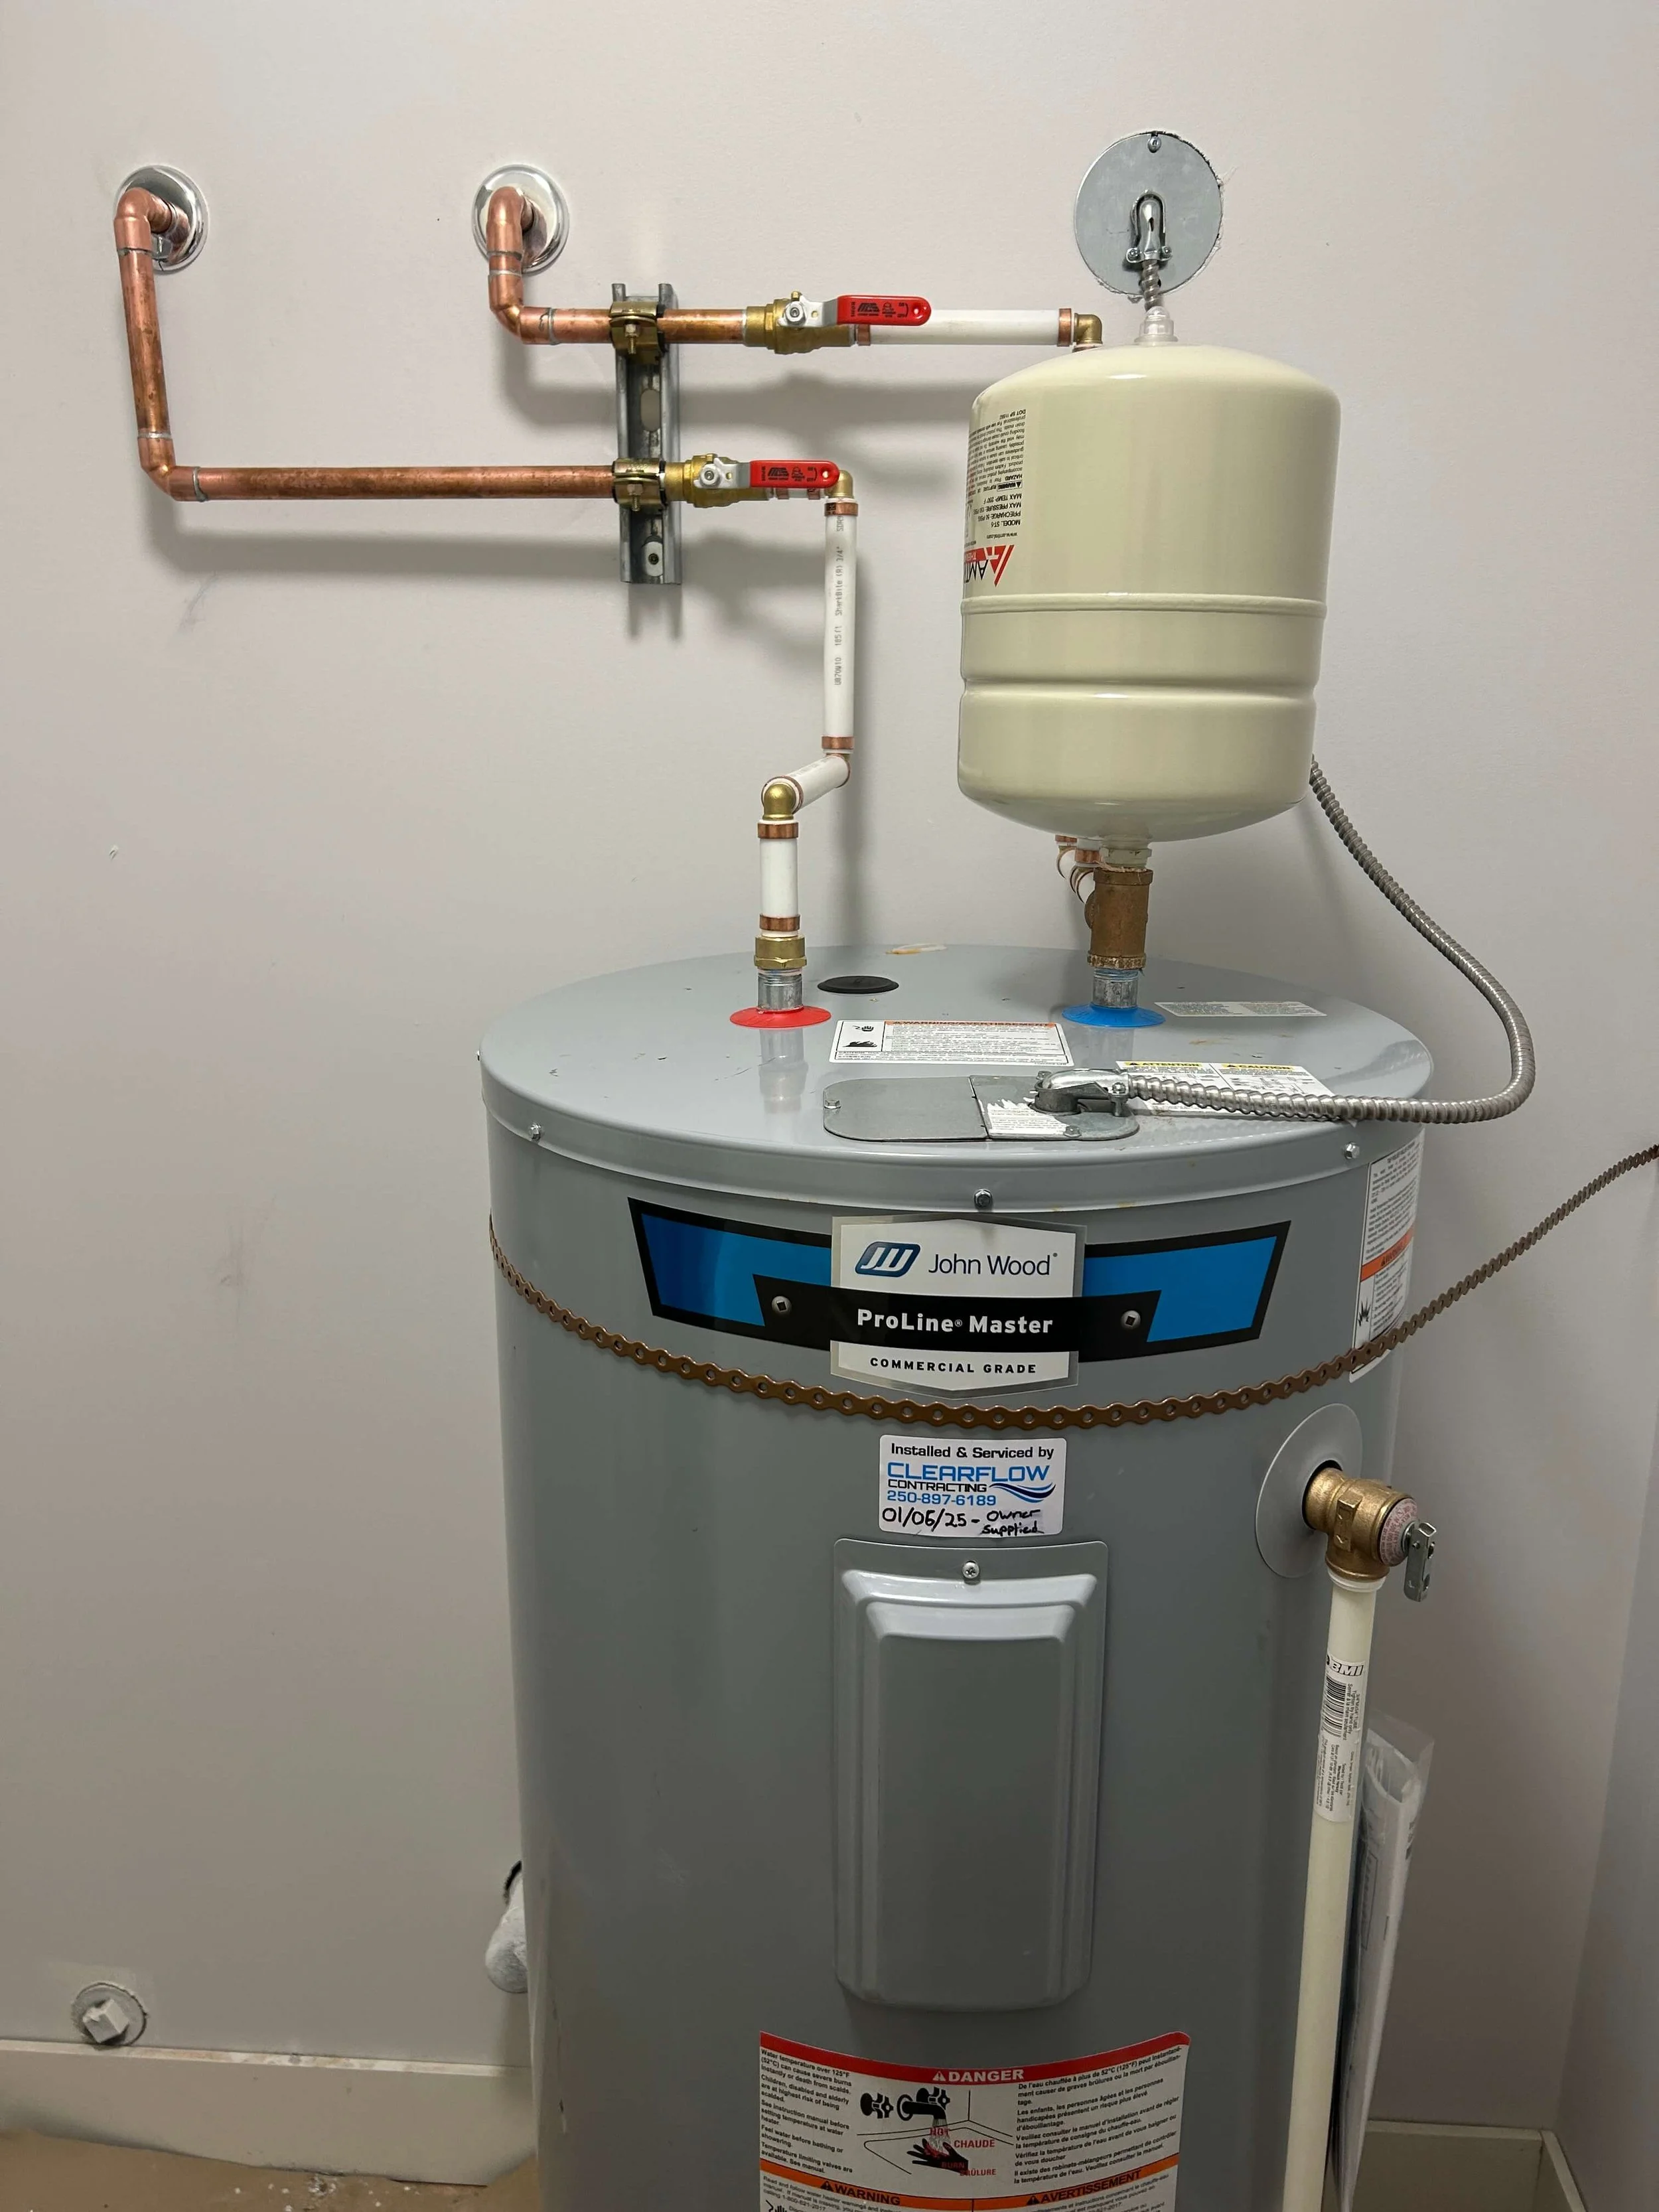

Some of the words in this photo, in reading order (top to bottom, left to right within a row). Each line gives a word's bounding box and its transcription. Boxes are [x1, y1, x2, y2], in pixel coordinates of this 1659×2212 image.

[928, 1254, 981, 1275] John
[970, 1315, 1053, 1333] Master
[870, 1358, 974, 1373] COMMERCIAL
[983, 1364, 1037, 1373] GRADE
[891, 1443, 950, 1457] Installed
[956, 1447, 968, 1458] &
[972, 1447, 1033, 1458] Serviced
[1039, 1447, 1054, 1459] by
[887, 1462, 1050, 1482] CLEARFLOW
[888, 1479, 987, 1493] CONTRACTING
[887, 1491, 996, 1506] 250-897-6189
[1329, 1662, 1364, 1676] BMI
[761, 2049, 778, 2059] Water
[780, 2055, 815, 2070] temperature
[761, 2057, 779, 2068] (52°C)
[793, 2067, 810, 2077] cause
[812, 2073, 832, 2082] severe
[834, 2077, 851, 2087] burns
[761, 2065, 786, 2078] instantly
[796, 2076, 812, 2085] death
[830, 2085, 851, 2094] scalds.
[949, 2069, 1025, 2082] DANGER
[761, 2074, 787, 2088] Children,
[789, 2083, 814, 2095] disabled
[829, 2095, 849, 2104] elderly
[761, 2091, 784, 2102] scalded.
[779, 2089, 800, 2099] highest
[823, 2101, 839, 2110] being
[761, 2108, 781, 2120] setting
[782, 2114, 818, 2129] temperature
[774, 2103, 805, 2118] instruction
[806, 2115, 828, 2124] manual
[830, 2120, 849, 2130] before
[761, 2133, 792, 2148] showering.
[792, 2134, 811, 2144] before
[812, 2140, 835, 2152] bathing
[954, 2140, 995, 2148] CHAUDE
[761, 2150, 788, 2162] available.
[802, 2164, 825, 2174] manual.
[762, 2142, 797, 2158] Temperature
[799, 2153, 821, 2166] limiting
[823, 2162, 841, 2170] valves
[835, 2184, 901, 2205] WARNING
[1041, 2170, 1141, 2203] AVERTISSEMENT
